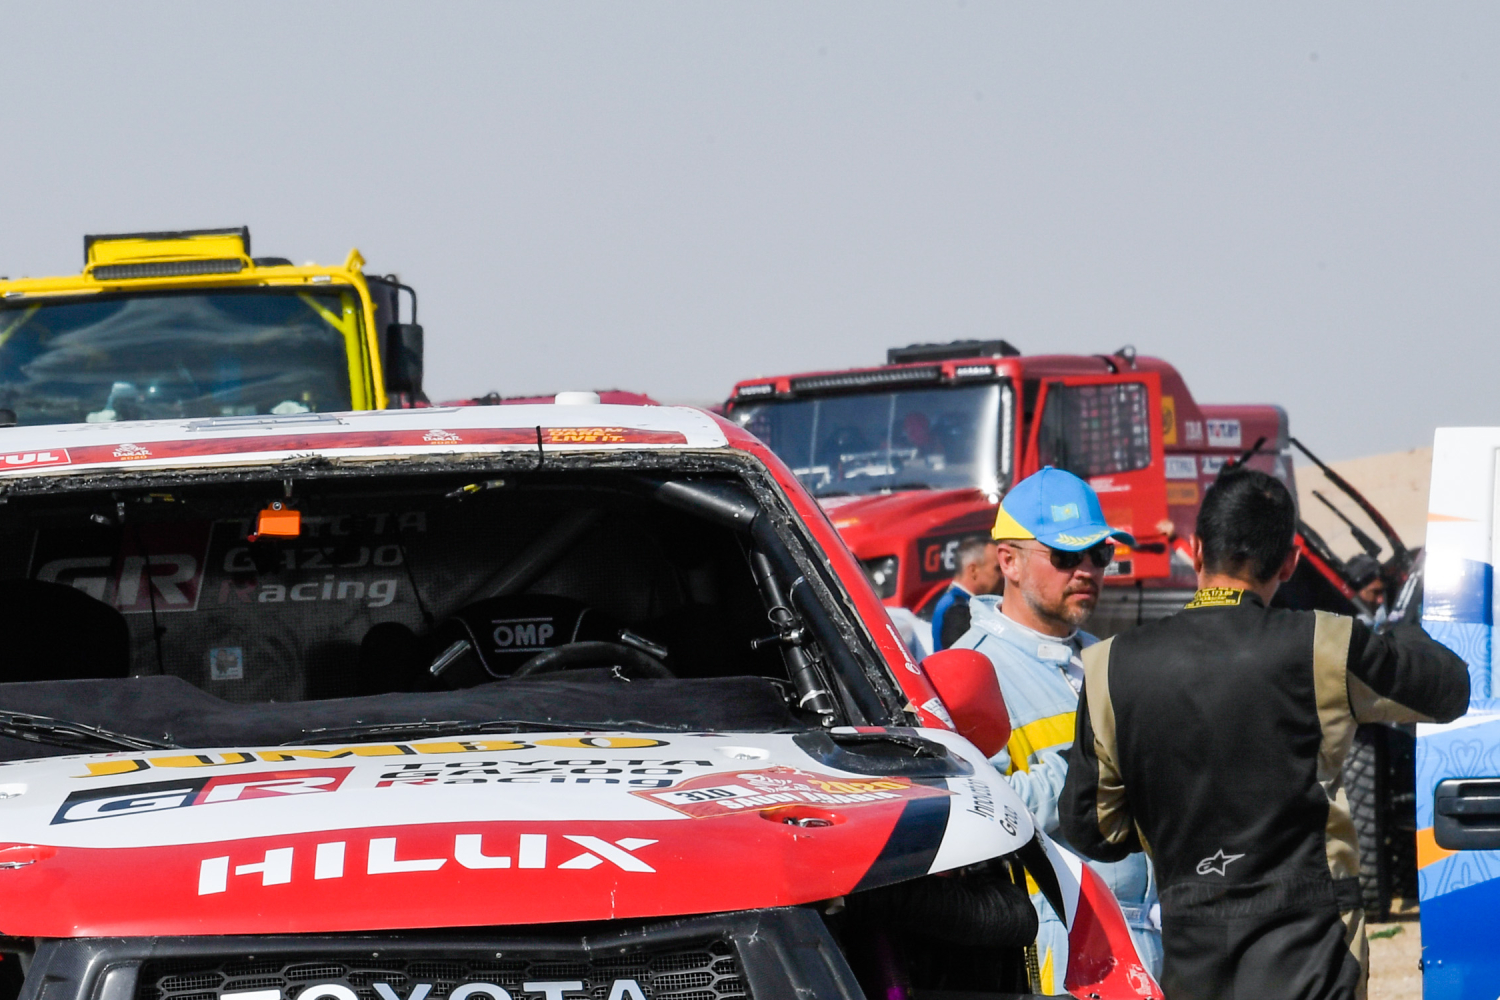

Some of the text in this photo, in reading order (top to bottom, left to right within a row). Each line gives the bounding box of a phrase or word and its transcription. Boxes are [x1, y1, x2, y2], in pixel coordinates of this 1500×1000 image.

[112, 449, 152, 457] DAKAR
[37, 554, 200, 606] GR
[493, 623, 554, 647] OMP
[85, 737, 672, 778] JUMBO
[384, 759, 714, 771] TOYOTA
[374, 775, 674, 789] Racing
[379, 767, 683, 779] GAZOO
[60, 775, 346, 821] GR
[675, 787, 733, 802] 310
[999, 804, 1018, 836] Group
[197, 834, 660, 897] HILUX
